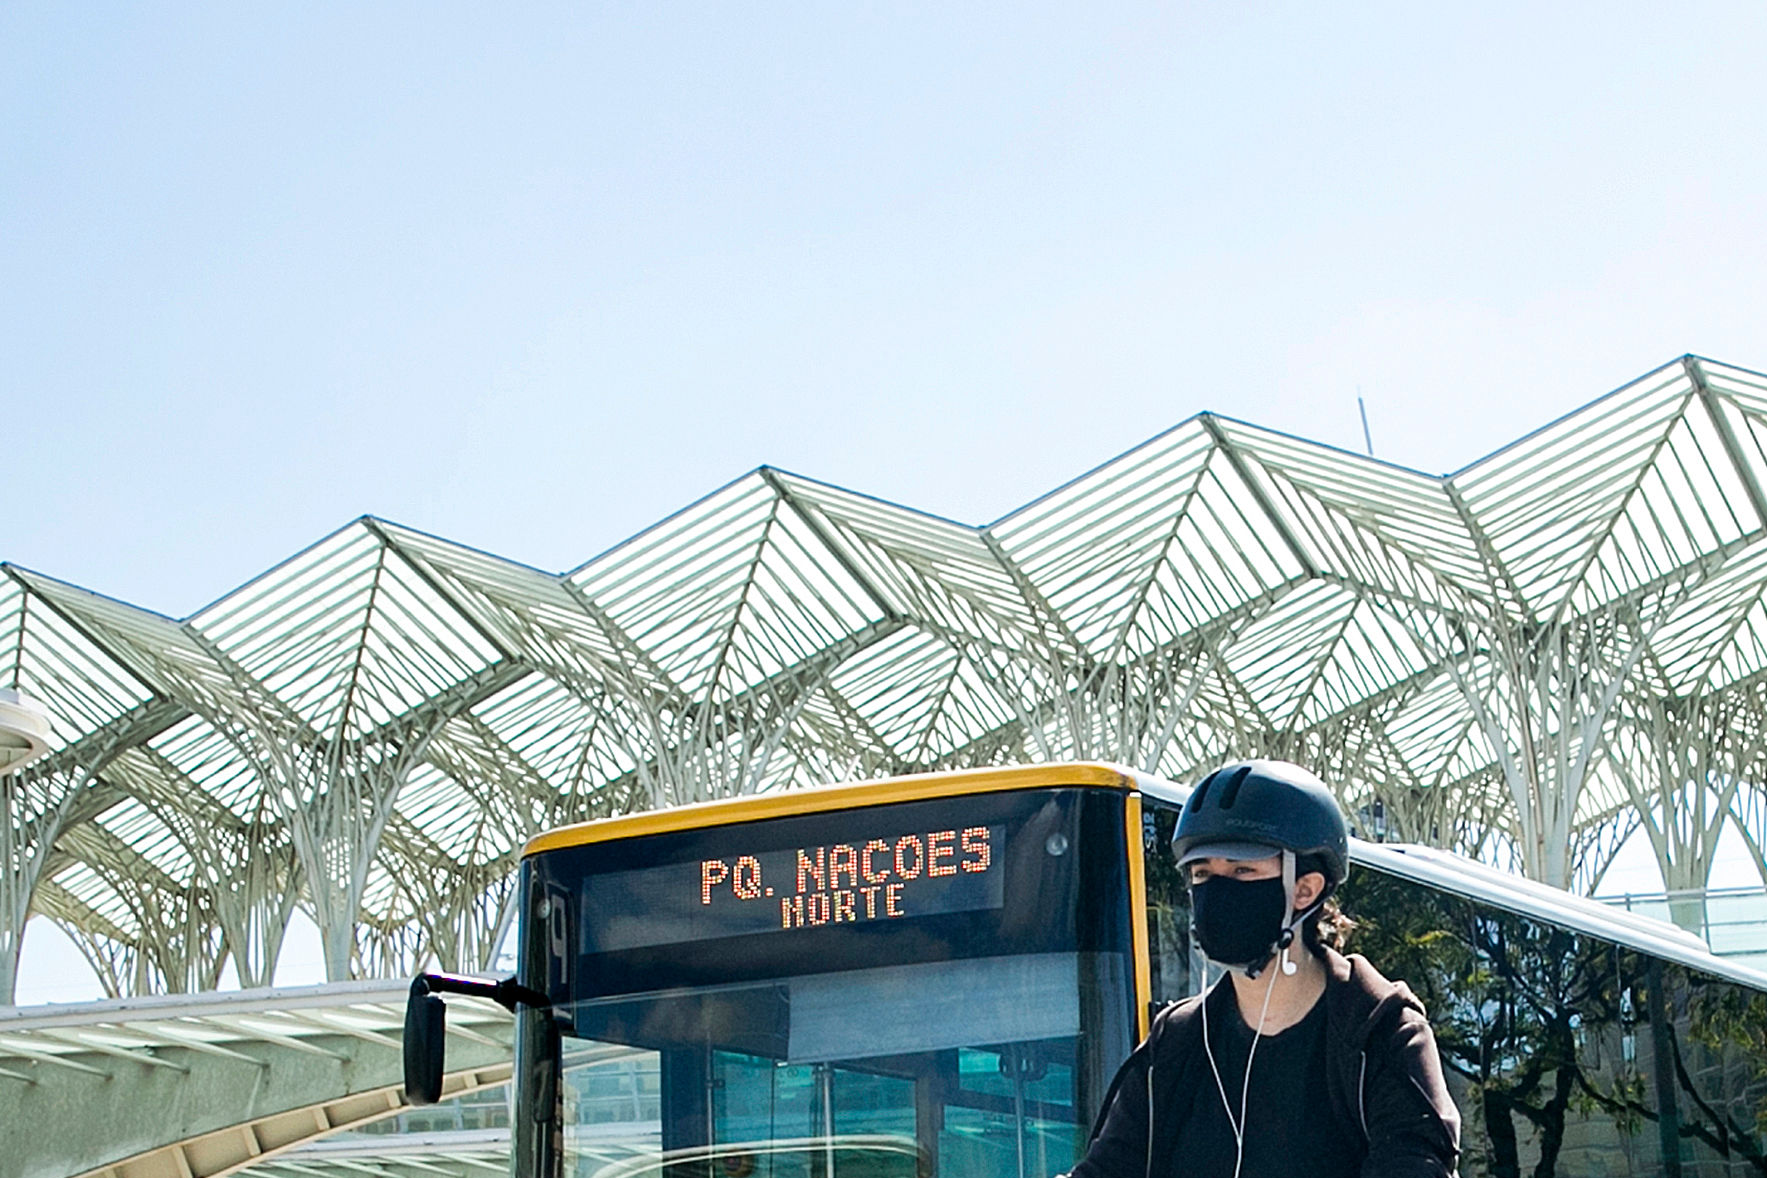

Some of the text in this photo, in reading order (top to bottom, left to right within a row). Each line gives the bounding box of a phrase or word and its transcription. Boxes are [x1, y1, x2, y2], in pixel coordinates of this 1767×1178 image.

[701, 826, 991, 905] PQ. NACOES
[780, 882, 905, 930] NORTE
